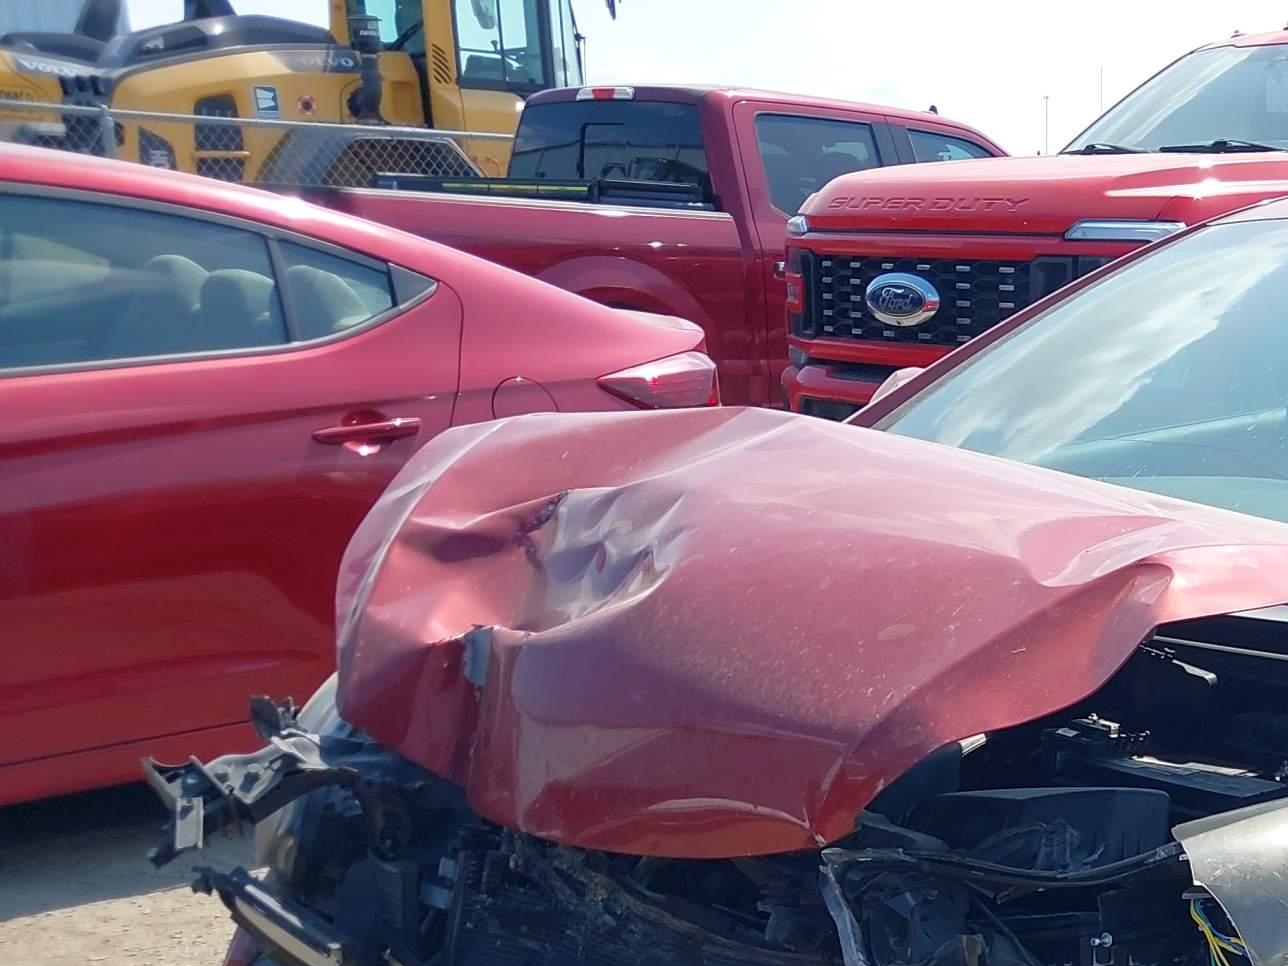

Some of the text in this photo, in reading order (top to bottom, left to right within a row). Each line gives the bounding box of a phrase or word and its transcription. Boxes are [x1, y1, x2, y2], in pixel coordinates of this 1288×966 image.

[827, 196, 1030, 212] SUPER DUTY
[878, 286, 914, 311] Ford
